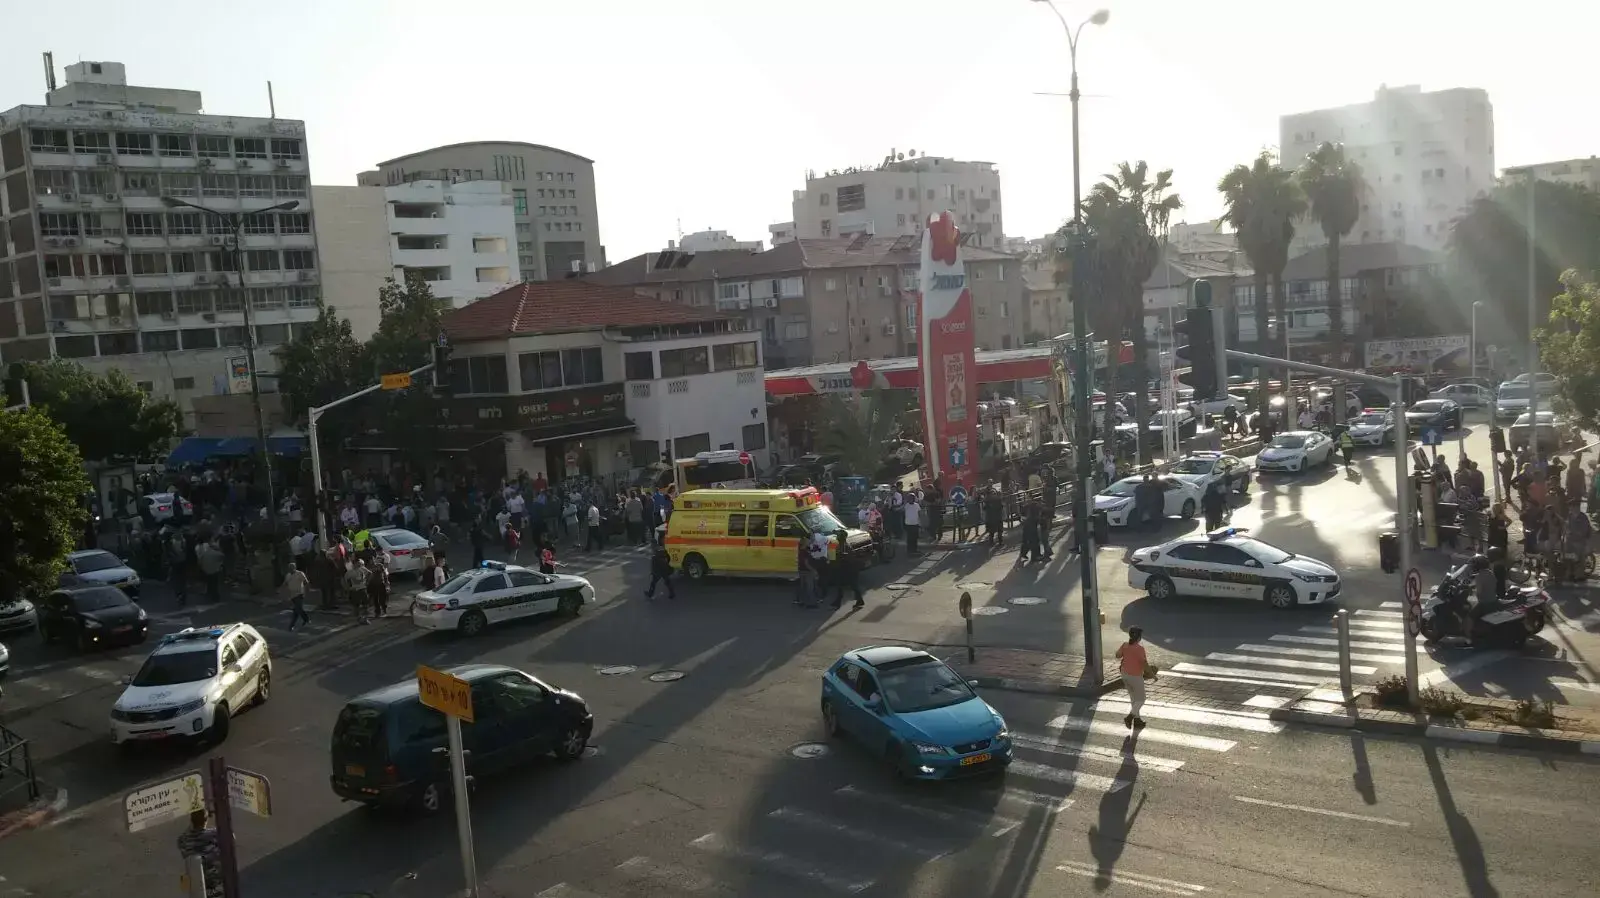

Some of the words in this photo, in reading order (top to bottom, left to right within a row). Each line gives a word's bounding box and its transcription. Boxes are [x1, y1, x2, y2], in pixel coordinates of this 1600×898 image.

[457, 690, 468, 710] 10
[131, 793, 157, 807] הקורא
[159, 789, 170, 800] עין
[132, 809, 143, 817] EIN
[144, 800, 172, 813] HA-KORE
